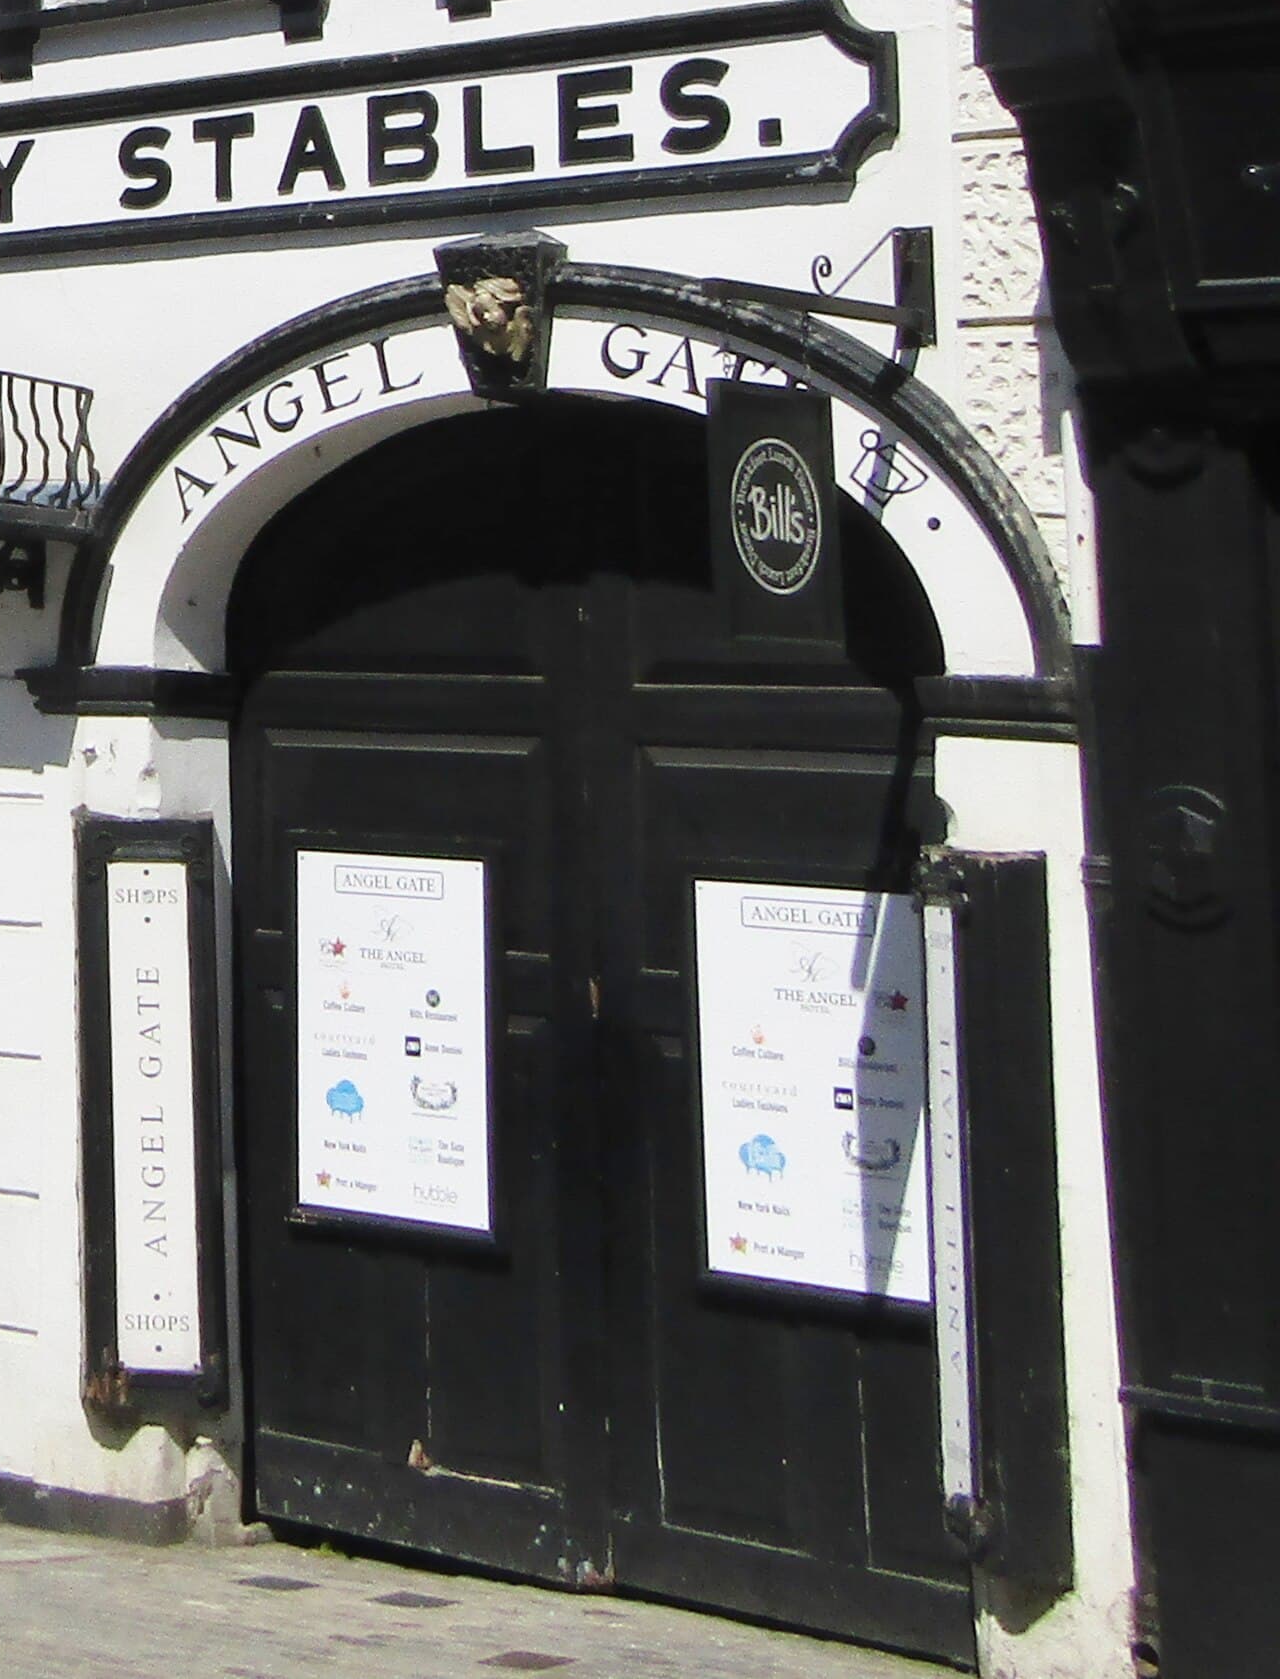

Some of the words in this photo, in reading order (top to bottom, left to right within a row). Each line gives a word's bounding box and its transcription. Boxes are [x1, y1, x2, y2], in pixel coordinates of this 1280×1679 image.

[118, 59, 783, 209] STABLES.
[174, 337, 424, 524] ANGEL
[601, 323, 809, 399] GAT
[747, 483, 805, 544] Bill's
[342, 873, 391, 890] ANGEL
[396, 876, 436, 893] GATE
[114, 887, 179, 906] SHOPS
[750, 905, 812, 924] ANGEL
[359, 947, 383, 961] THE
[386, 951, 427, 965] ANGEL
[773, 987, 804, 1003] THE
[807, 991, 857, 1007] ANGEL
[136, 966, 162, 1079] GATE
[141, 1104, 168, 1258] ANGEL
[124, 1313, 191, 1332] SHOPS
